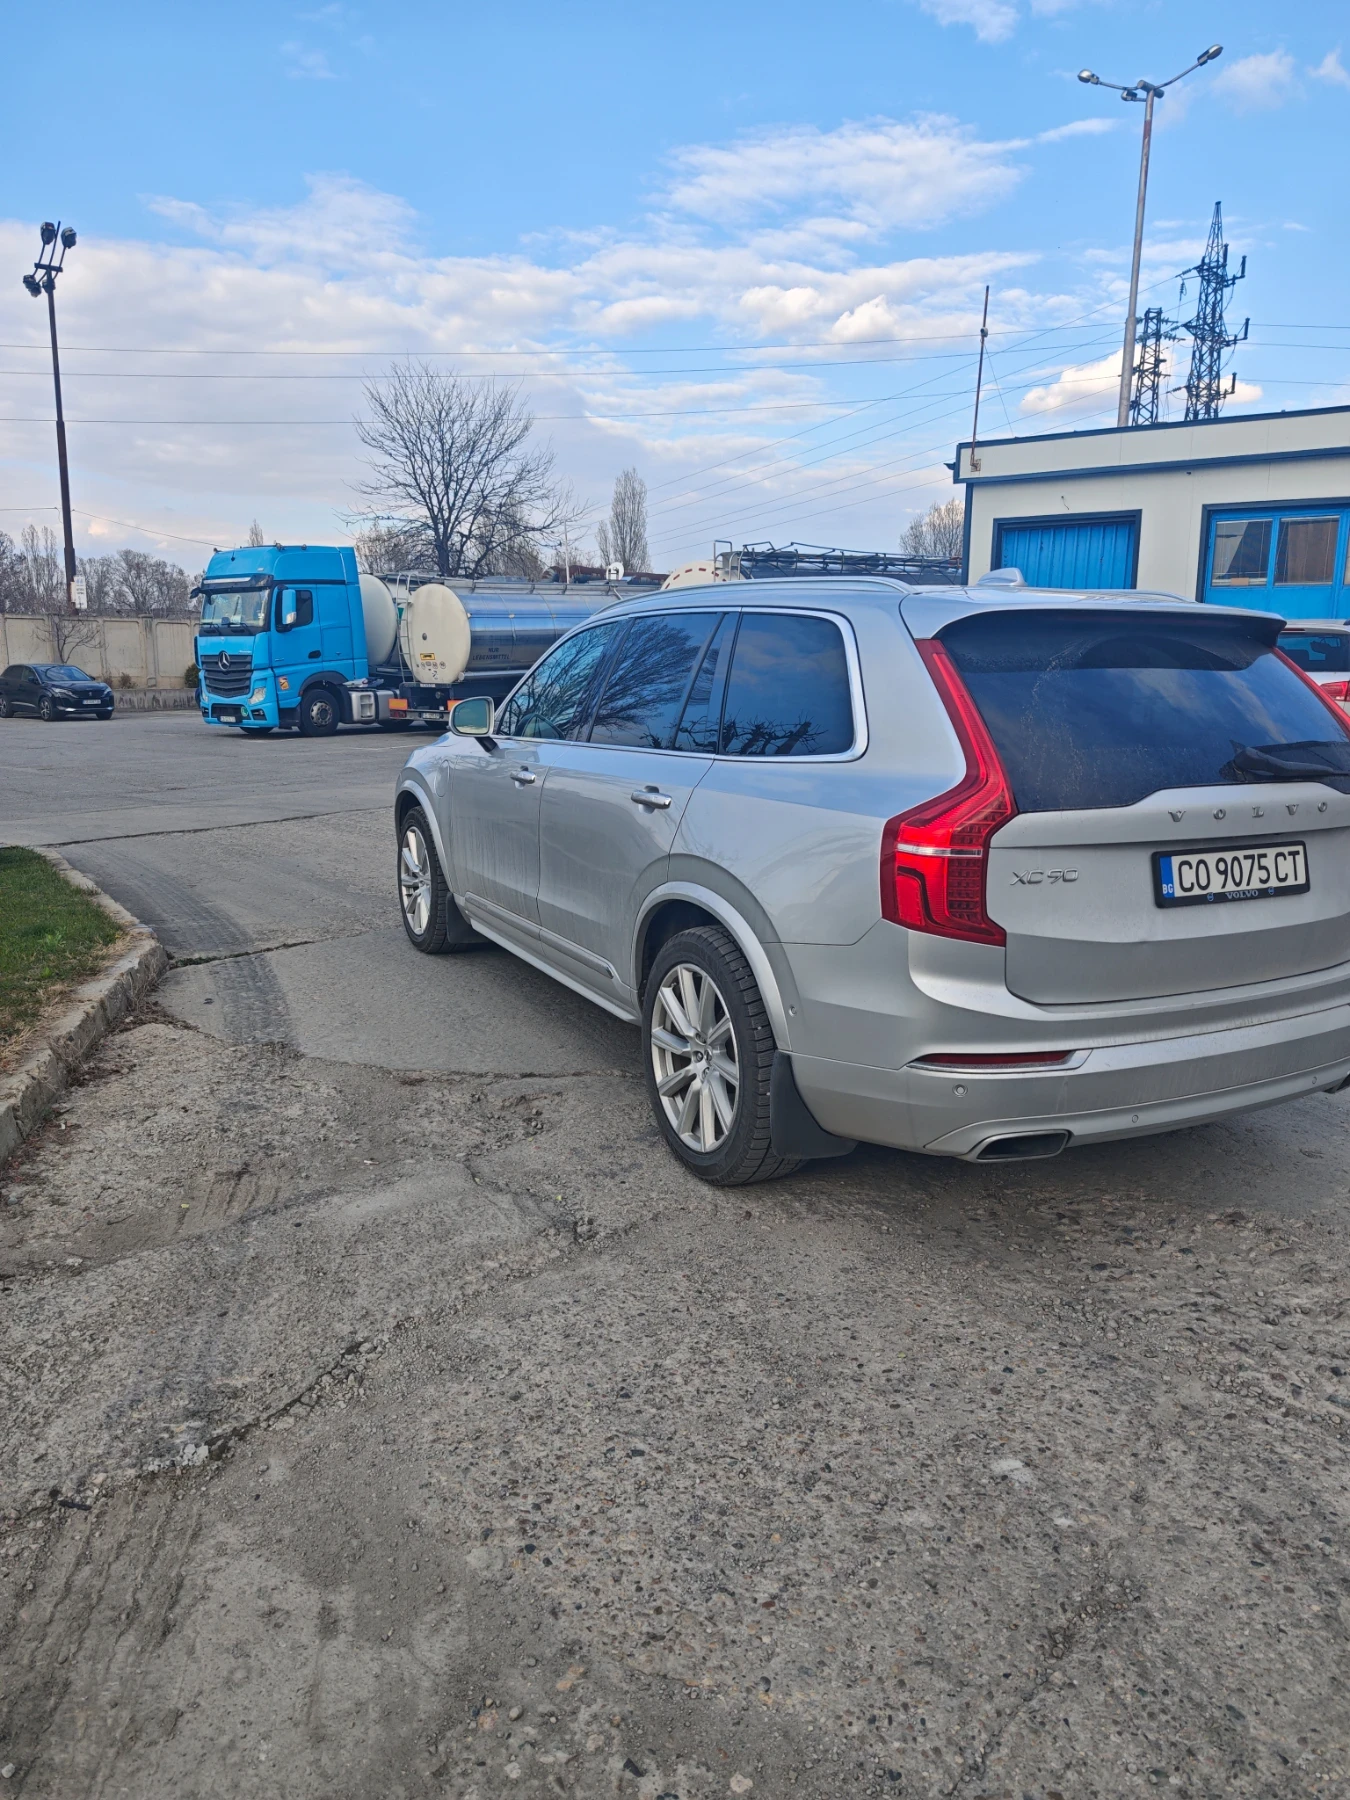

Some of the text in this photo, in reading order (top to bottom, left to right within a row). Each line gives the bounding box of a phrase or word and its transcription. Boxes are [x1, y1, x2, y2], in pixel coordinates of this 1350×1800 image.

[1168, 802, 1328, 823] VOLVO
[1010, 868, 1079, 886] XC90
[1162, 883, 1174, 894] BG
[1225, 889, 1259, 899] VOLVO
